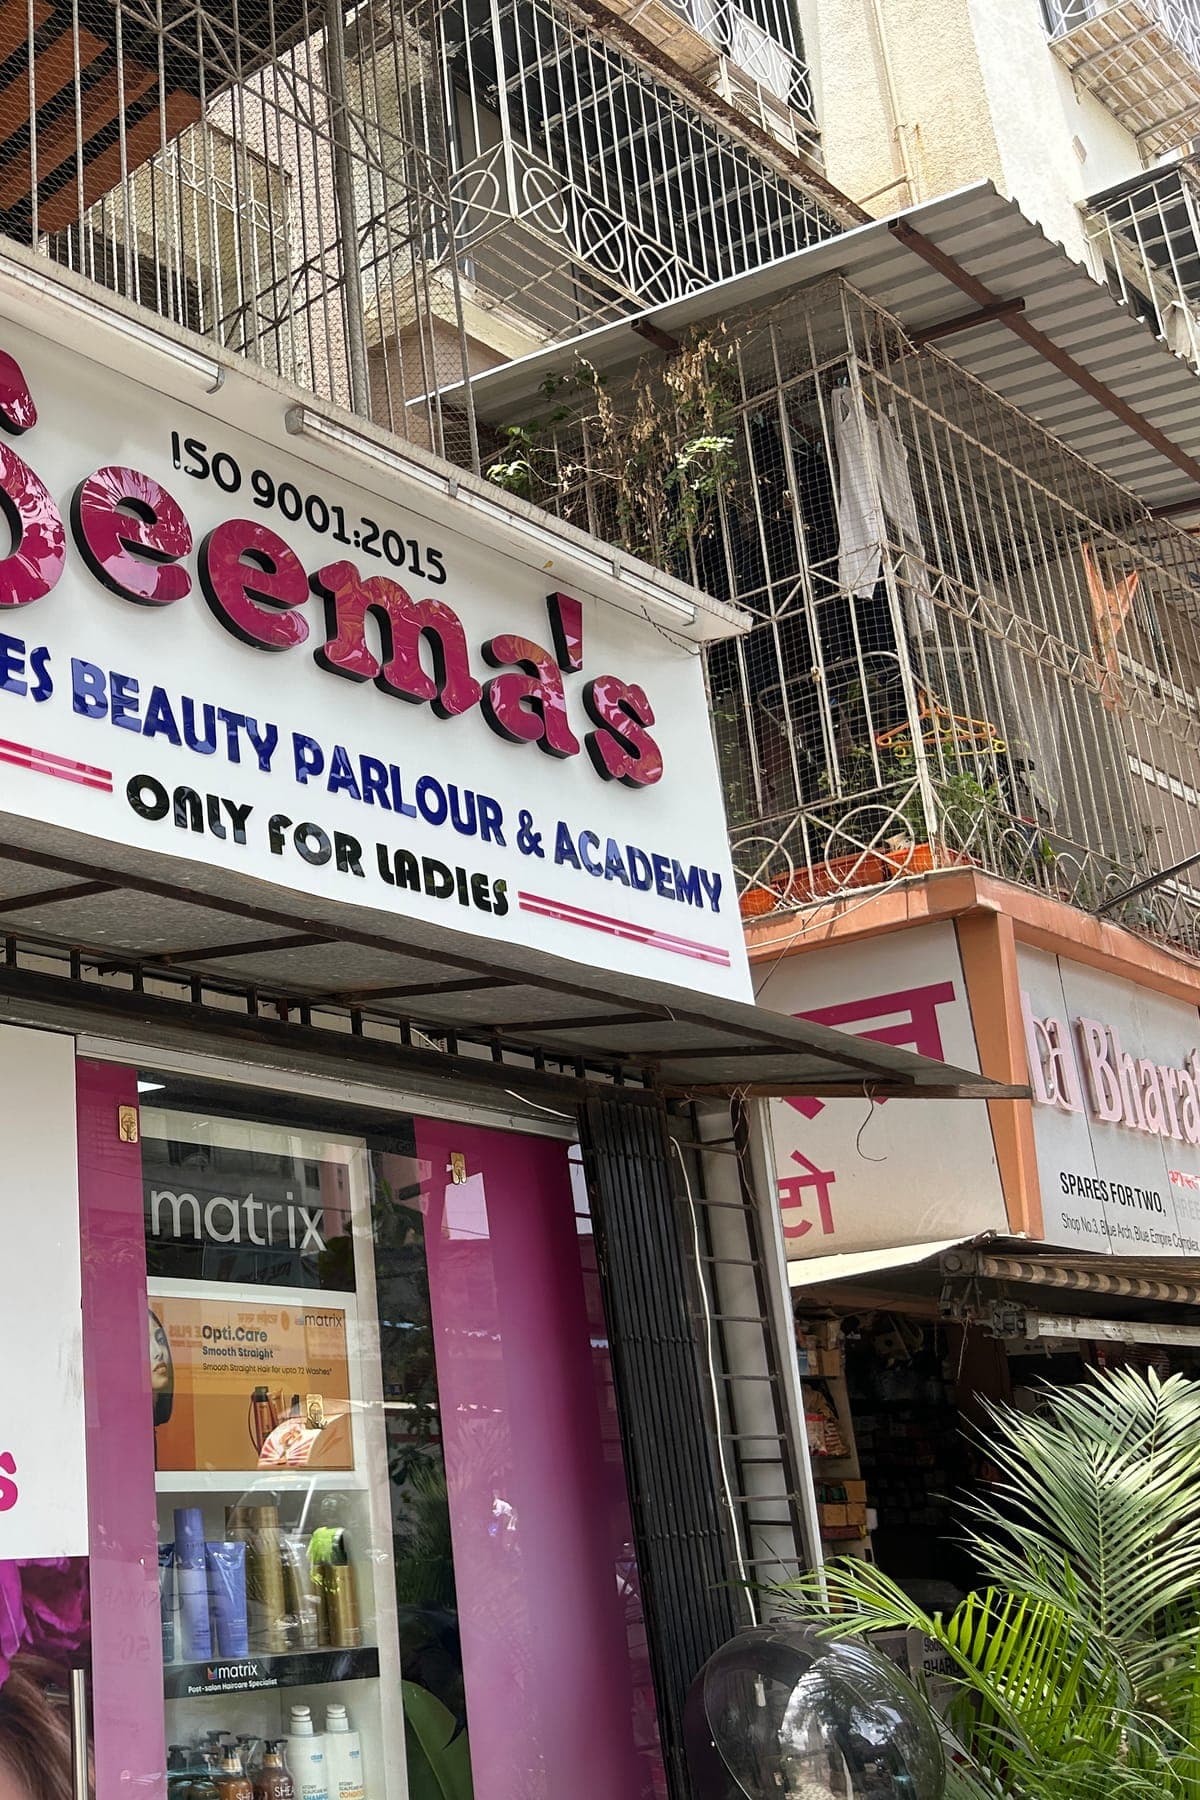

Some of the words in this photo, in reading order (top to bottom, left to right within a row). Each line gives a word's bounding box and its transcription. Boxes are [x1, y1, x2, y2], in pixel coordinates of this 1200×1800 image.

[171, 431, 241, 493] ISO
[252, 470, 447, 584] 9001:2015
[71, 657, 278, 772] BEAUTY
[293, 732, 507, 847] PARLOUR
[517, 809, 545, 858] &
[554, 821, 721, 913] ACADEMY
[126, 774, 253, 845] ONLY
[269, 814, 365, 878] FOR
[376, 843, 508, 916] LADIES
[1060, 1172, 1108, 1202] SPARES
[1109, 1182, 1135, 1207] FOR
[1134, 1188, 1166, 1216] TWO,
[151, 1190, 327, 1252] matrix
[1061, 1212, 1081, 1234] Shop
[304, 1313, 343, 1328] matrix
[202, 1325, 268, 1343] Opti.Care
[202, 1345, 237, 1357] Smooth
[238, 1347, 273, 1360] Straight
[202, 1363, 229, 1372] Smooth
[229, 1364, 256, 1374] Straight
[257, 1365, 270, 1373] Hair
[271, 1365, 281, 1373] for
[282, 1367, 297, 1375] upto
[218, 1662, 258, 1679] matrix
[222, 1681, 248, 1690] Haircare
[249, 1678, 278, 1687] Specialist
